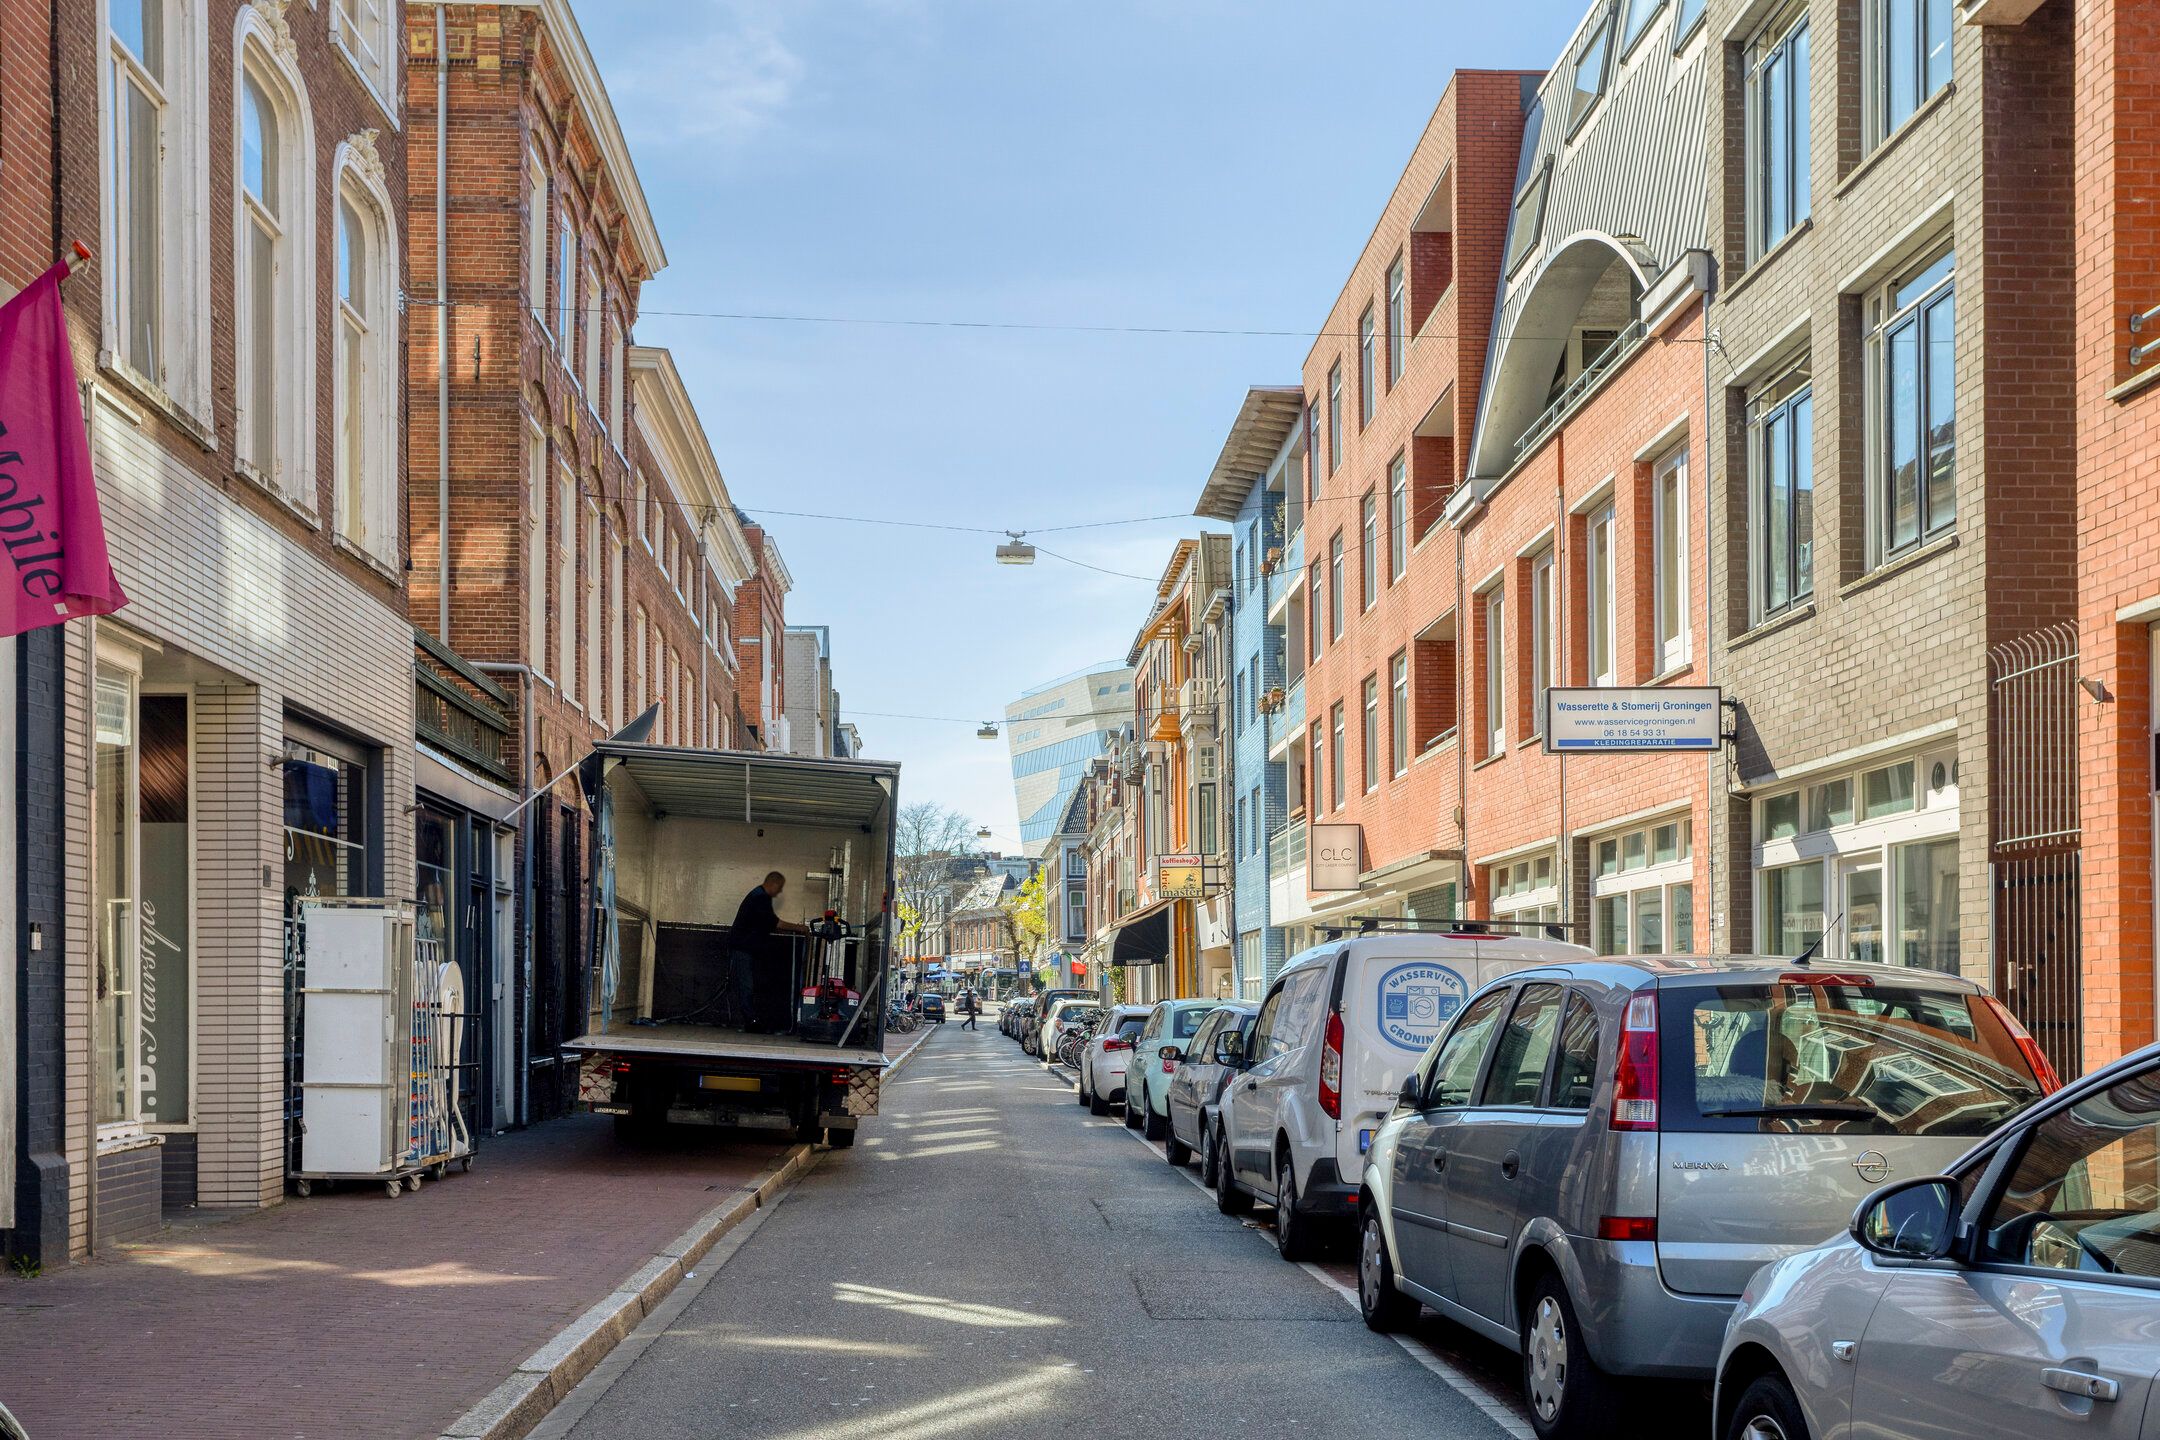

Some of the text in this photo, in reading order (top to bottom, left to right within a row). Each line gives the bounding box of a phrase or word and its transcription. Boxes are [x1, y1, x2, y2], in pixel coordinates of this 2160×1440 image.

[1557, 701, 1712, 712] Wasserette & Stomerij Groningen
[1574, 718, 1696, 727] www.wasservicegroningen.nl
[1603, 729, 1614, 737] 06
[1618, 729, 1628, 737] 18
[1630, 729, 1640, 737] 54
[1643, 729, 1654, 737] 93
[1320, 847, 1352, 861] CLC
[1161, 857, 1193, 865] koffieshop
[1162, 888, 1202, 897] master
[1388, 970, 1459, 990] WASSERVICE
[1672, 1161, 1729, 1171] MERIVA
